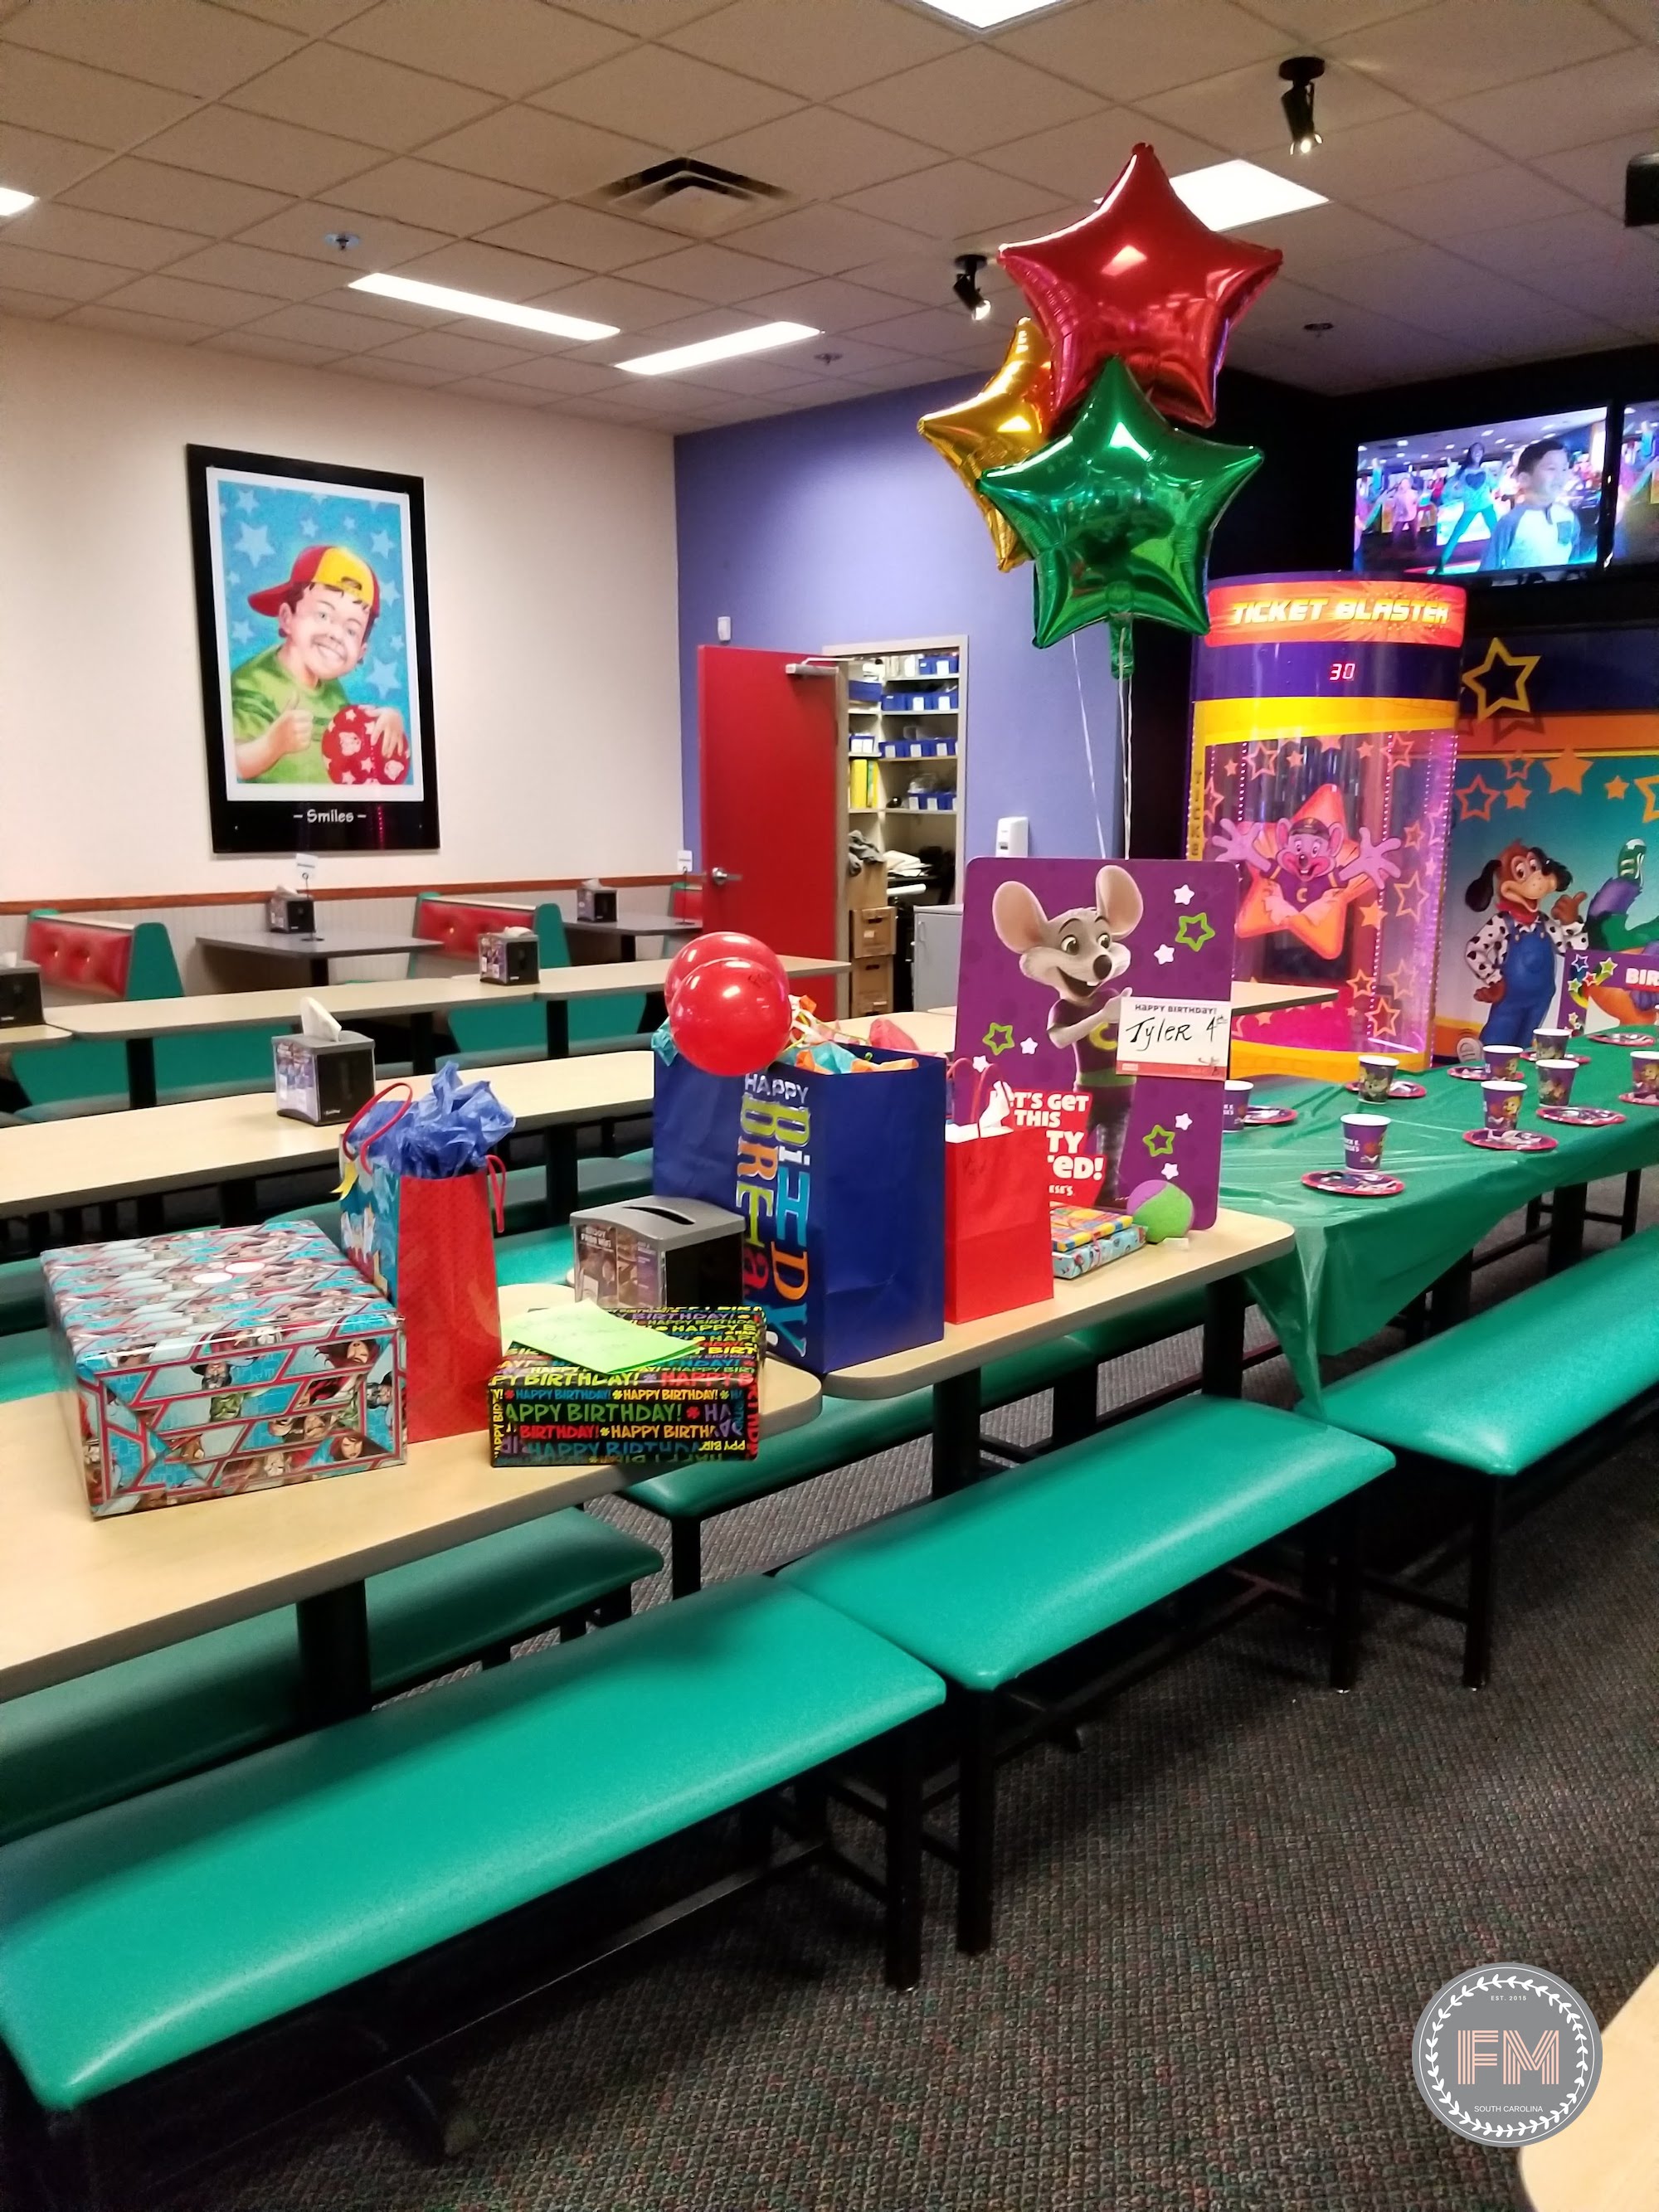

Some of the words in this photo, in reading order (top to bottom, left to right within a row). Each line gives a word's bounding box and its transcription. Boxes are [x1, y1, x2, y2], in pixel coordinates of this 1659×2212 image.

[1231, 597, 1329, 625] TICKET
[1333, 597, 1452, 625] BLASTER
[1330, 663, 1356, 682] 30
[306, 809, 354, 824] Smiles
[744, 1073, 810, 1104] HAPPY
[1010, 1091, 1044, 1110] T'S
[1014, 1109, 1062, 1128] THIS
[623, 1389, 661, 1401] HAPPY
[662, 1389, 718, 1400] BIRTHDAY!
[505, 1403, 562, 1422] APPY
[567, 1403, 682, 1422] BIRTHDAY!
[519, 1424, 600, 1439] BIRTHDAY!
[611, 1425, 659, 1438] HAPPY
